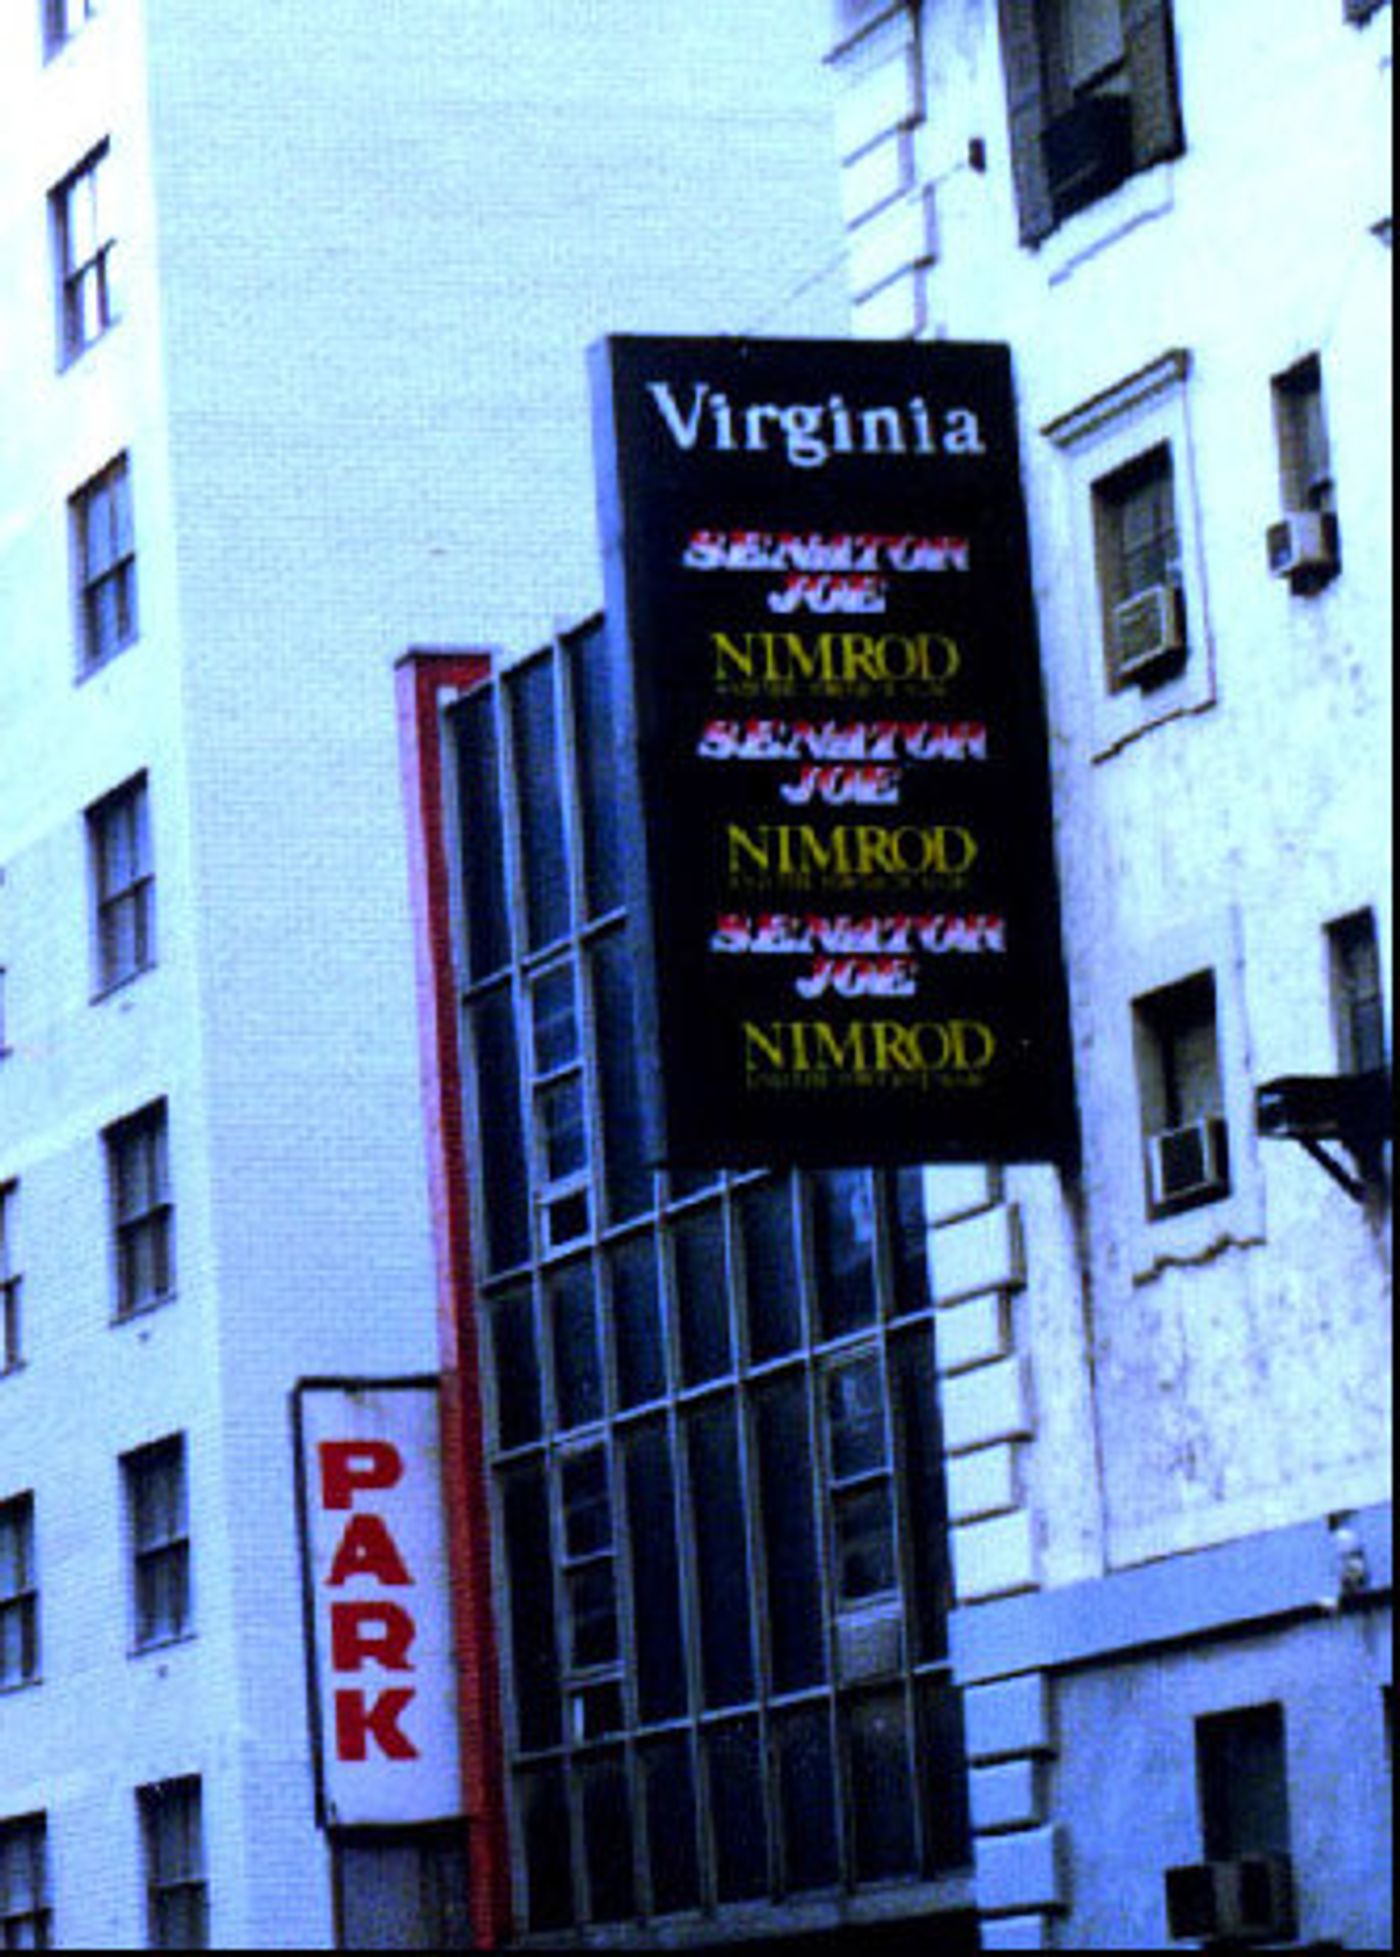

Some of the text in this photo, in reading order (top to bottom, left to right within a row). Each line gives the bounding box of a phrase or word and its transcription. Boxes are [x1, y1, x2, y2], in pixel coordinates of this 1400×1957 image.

[647, 380, 986, 467] Virginia
[682, 529, 970, 571] SENATOR
[766, 573, 888, 615] JOE
[712, 632, 961, 682] NIMROD
[697, 719, 987, 761] SENATOR
[780, 766, 900, 805] JOE
[727, 824, 979, 875] NIMROD
[710, 913, 1006, 954] SENATOR
[795, 957, 917, 999] JOE
[742, 1020, 997, 1072] NIMROD
[317, 1438, 420, 1762] PARK
